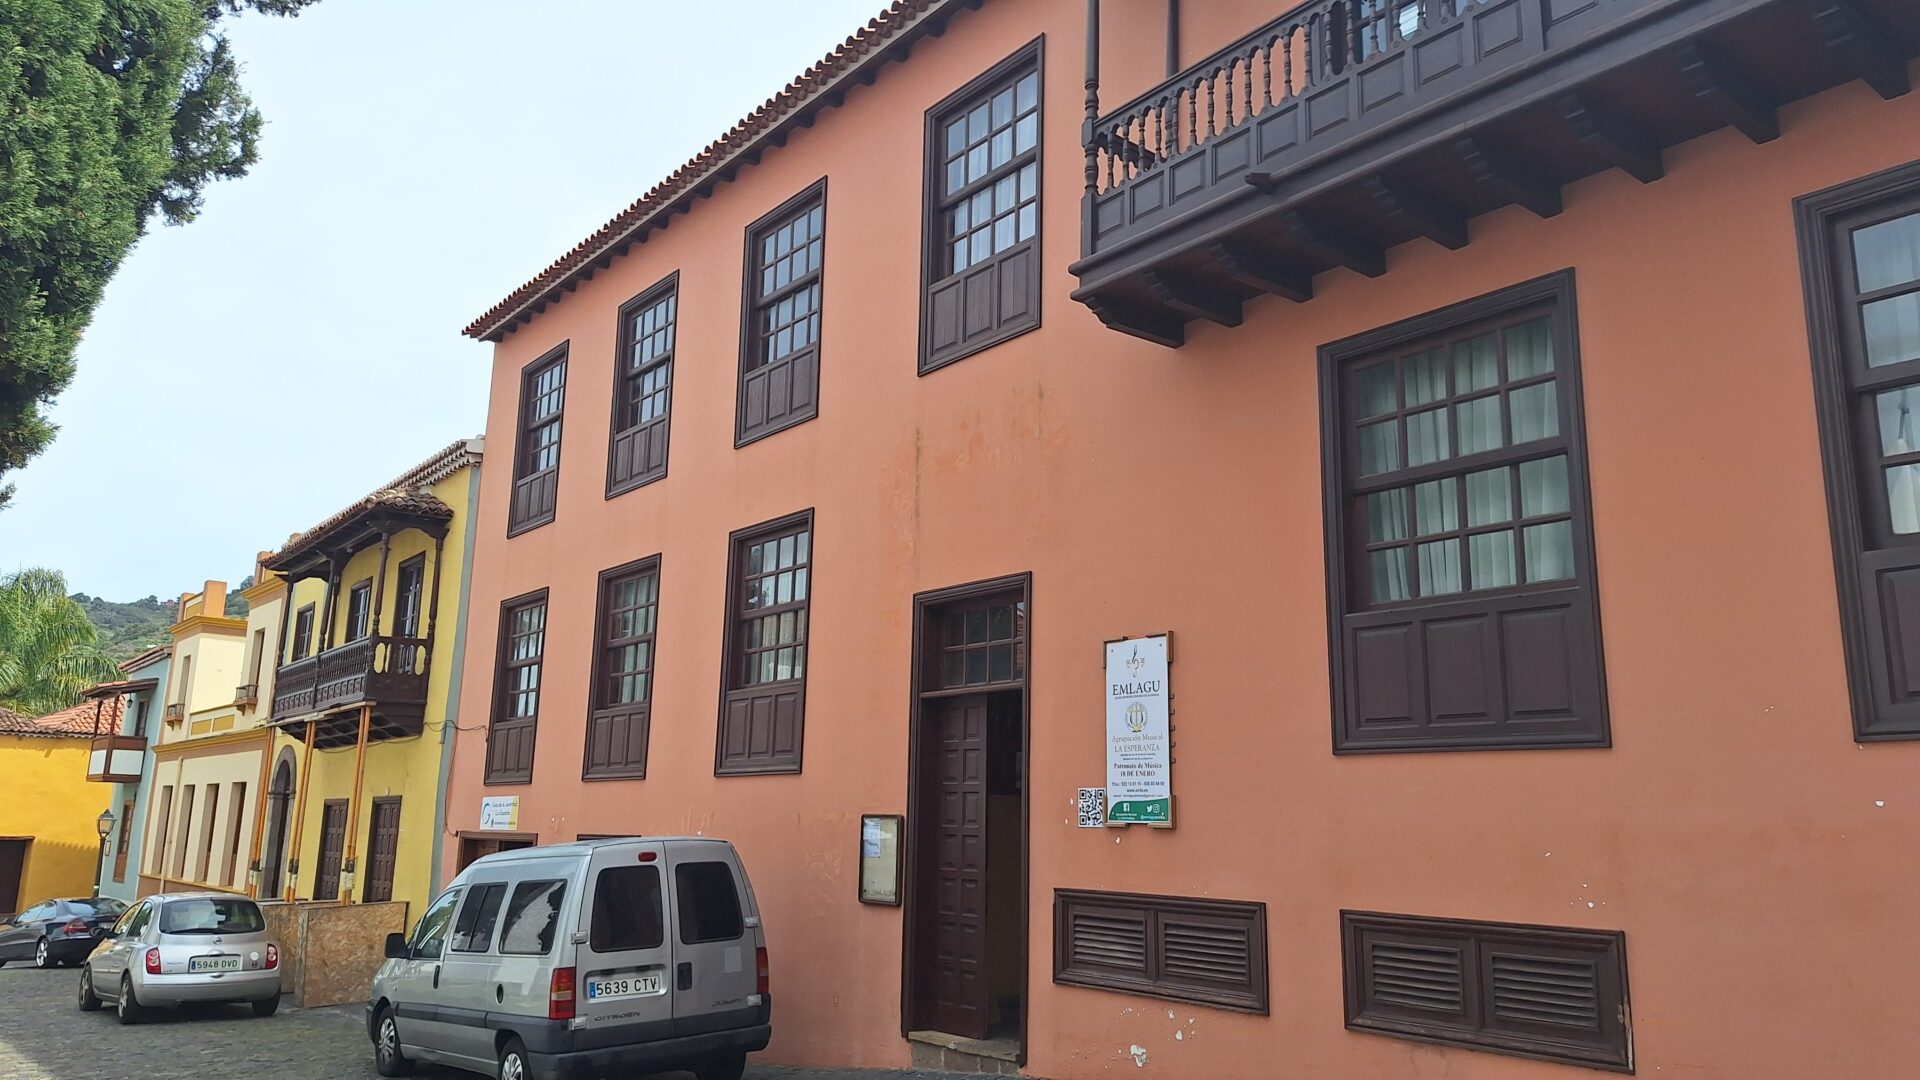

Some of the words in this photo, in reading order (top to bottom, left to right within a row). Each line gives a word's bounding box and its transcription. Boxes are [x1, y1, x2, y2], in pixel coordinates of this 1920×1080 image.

[1112, 680, 1160, 696] EMLAGU
[1111, 734, 1141, 743] Agrupación
[1142, 732, 1163, 741] Musical
[1114, 745, 1123, 753] LA
[1123, 743, 1160, 752] ESPERANZA
[197, 961, 219, 969] 5948
[221, 960, 238, 968] DVD
[596, 980, 628, 996] 5639
[634, 977, 657, 992] CTV
